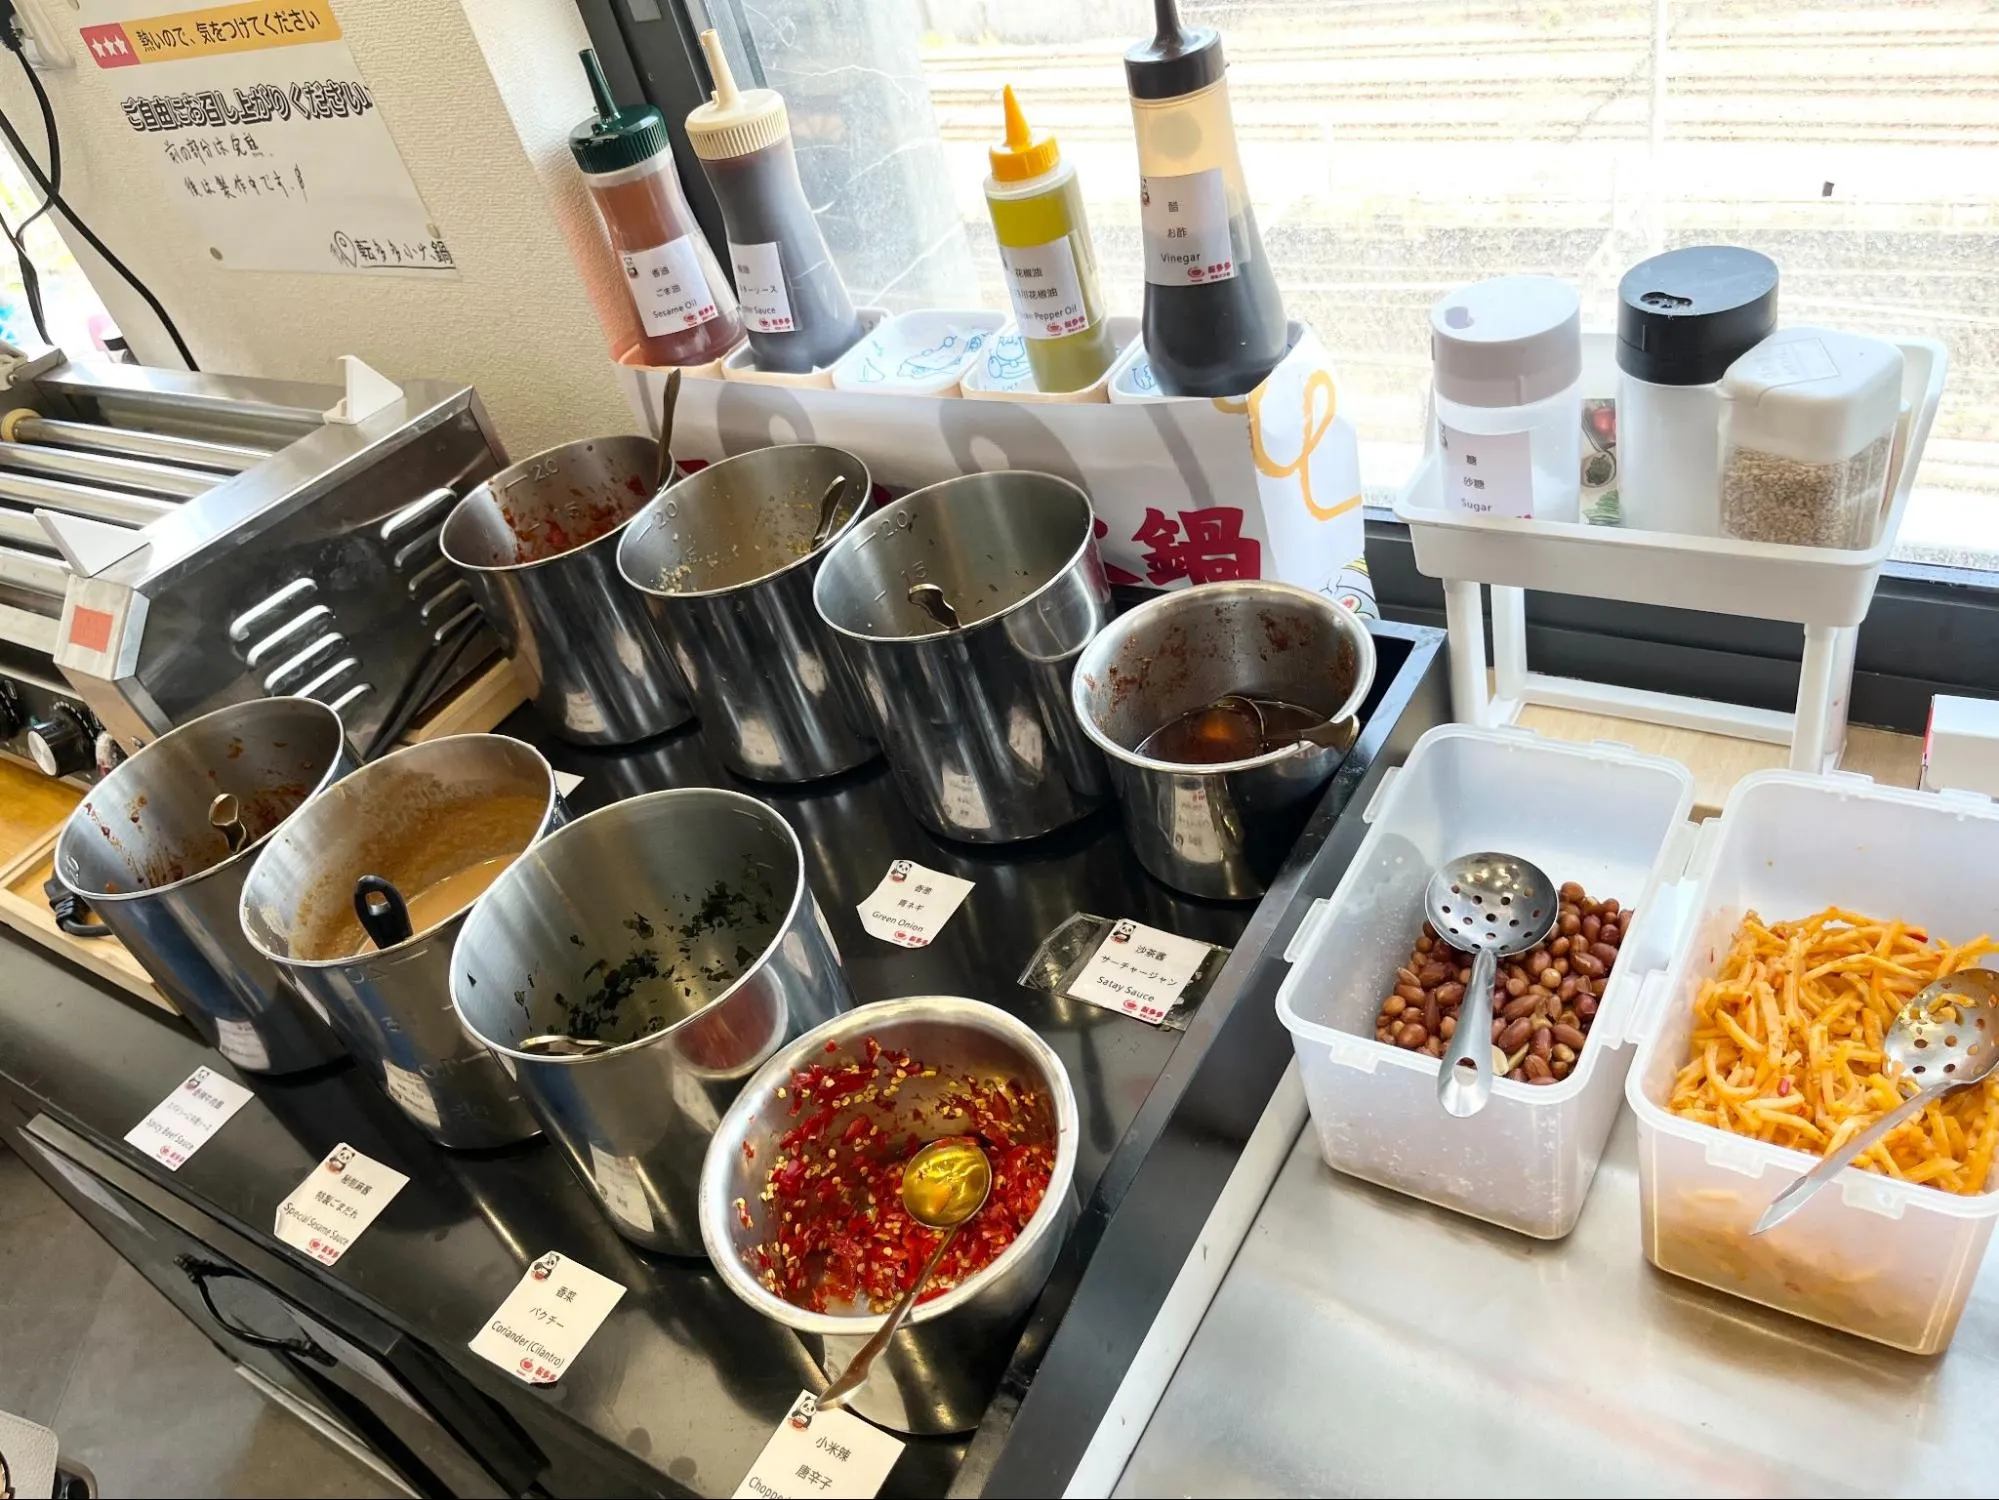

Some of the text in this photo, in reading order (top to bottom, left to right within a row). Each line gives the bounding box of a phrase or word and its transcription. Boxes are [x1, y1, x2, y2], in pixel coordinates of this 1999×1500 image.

[136, 8, 321, 52] 熱いので、気をつけてください
[121, 79, 373, 132] ご自由にお召し上がりください
[1160, 252, 1201, 266] Vinegar
[652, 304, 685, 319] Sesame
[684, 298, 697, 310] Oil
[753, 306, 776, 315] Sauce
[1033, 310, 1064, 322] Pepper
[1064, 303, 1078, 315] Oil
[1460, 497, 1493, 513] Sugar
[871, 910, 924, 933] Green Onion
[1096, 976, 1155, 1003] Satay Sauce
[283, 1202, 350, 1247] Special Sesame Sauce
[556, 1285, 578, 1303] 香菜
[528, 1306, 566, 1330] パクチー
[491, 1319, 565, 1370] Coriander (Cilantro)
[815, 1436, 852, 1463] 小米辣
[794, 1463, 834, 1492] 唐辛子
